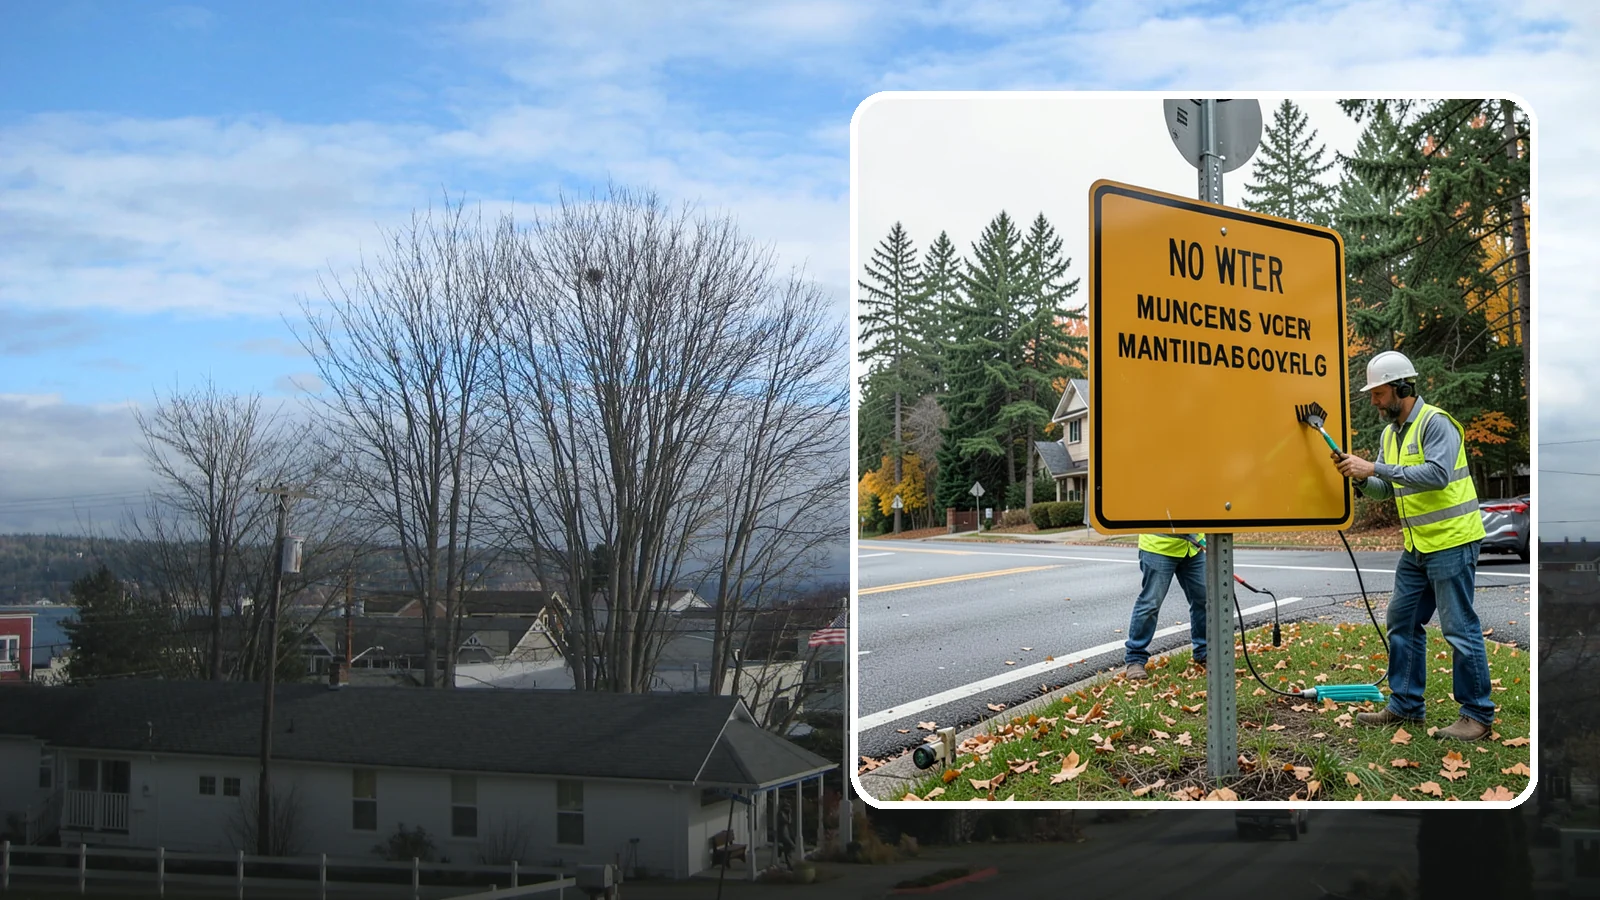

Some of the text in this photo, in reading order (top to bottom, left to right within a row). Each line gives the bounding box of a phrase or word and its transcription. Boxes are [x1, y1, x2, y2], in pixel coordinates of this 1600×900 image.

[1169, 237, 1284, 294] NO WTER
[1137, 293, 1252, 333] MUNCENS
